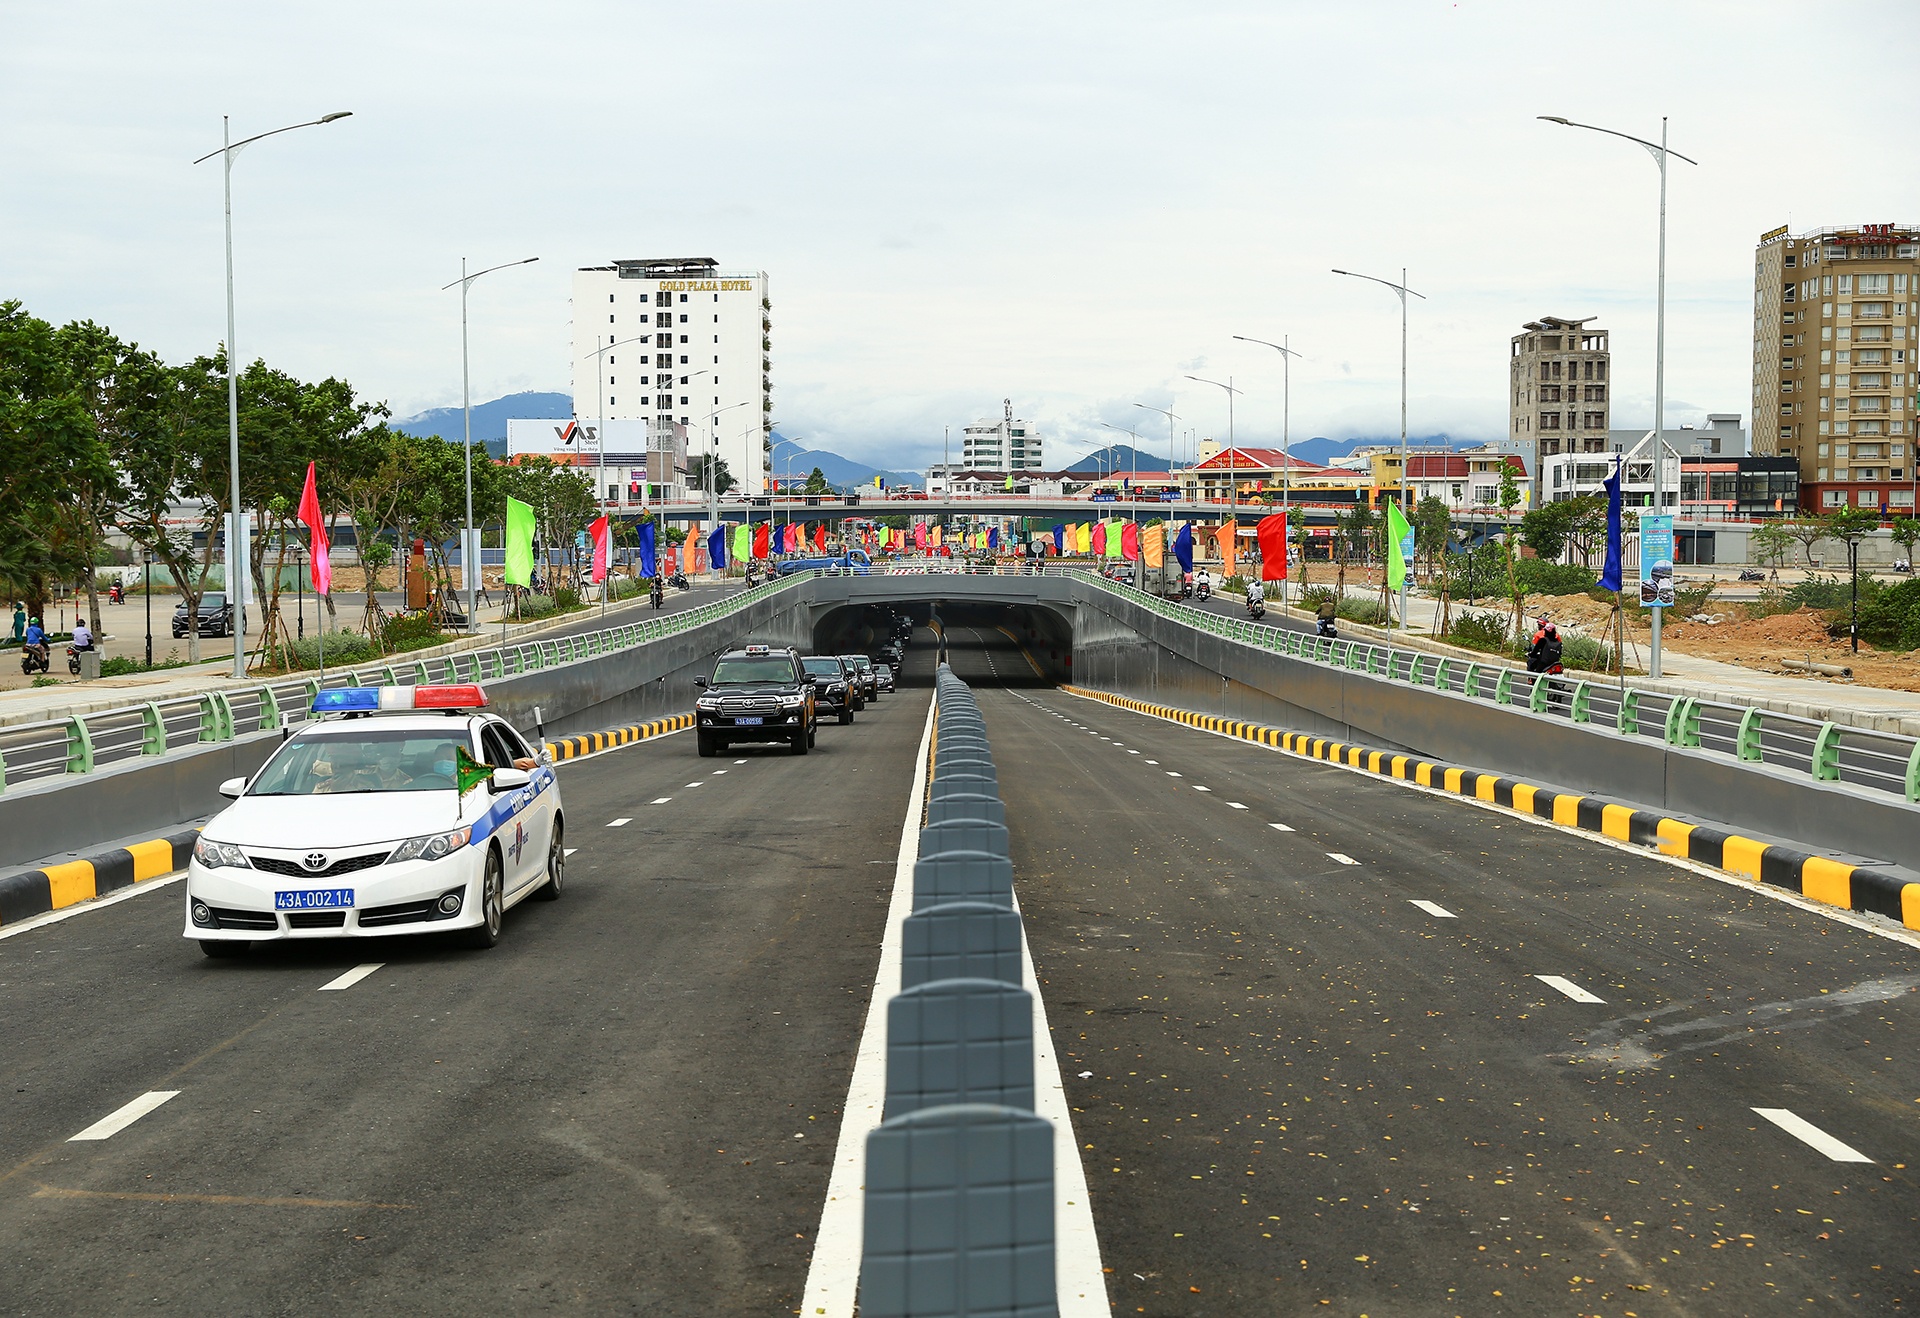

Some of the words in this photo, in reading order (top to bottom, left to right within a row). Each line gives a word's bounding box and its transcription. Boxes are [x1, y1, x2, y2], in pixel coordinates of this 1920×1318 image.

[660, 281, 686, 291] GOLD
[687, 281, 718, 291] PLAZA
[720, 280, 752, 291] HOTEL
[553, 421, 597, 445] VAS
[277, 890, 352, 908] 43A-002.14
